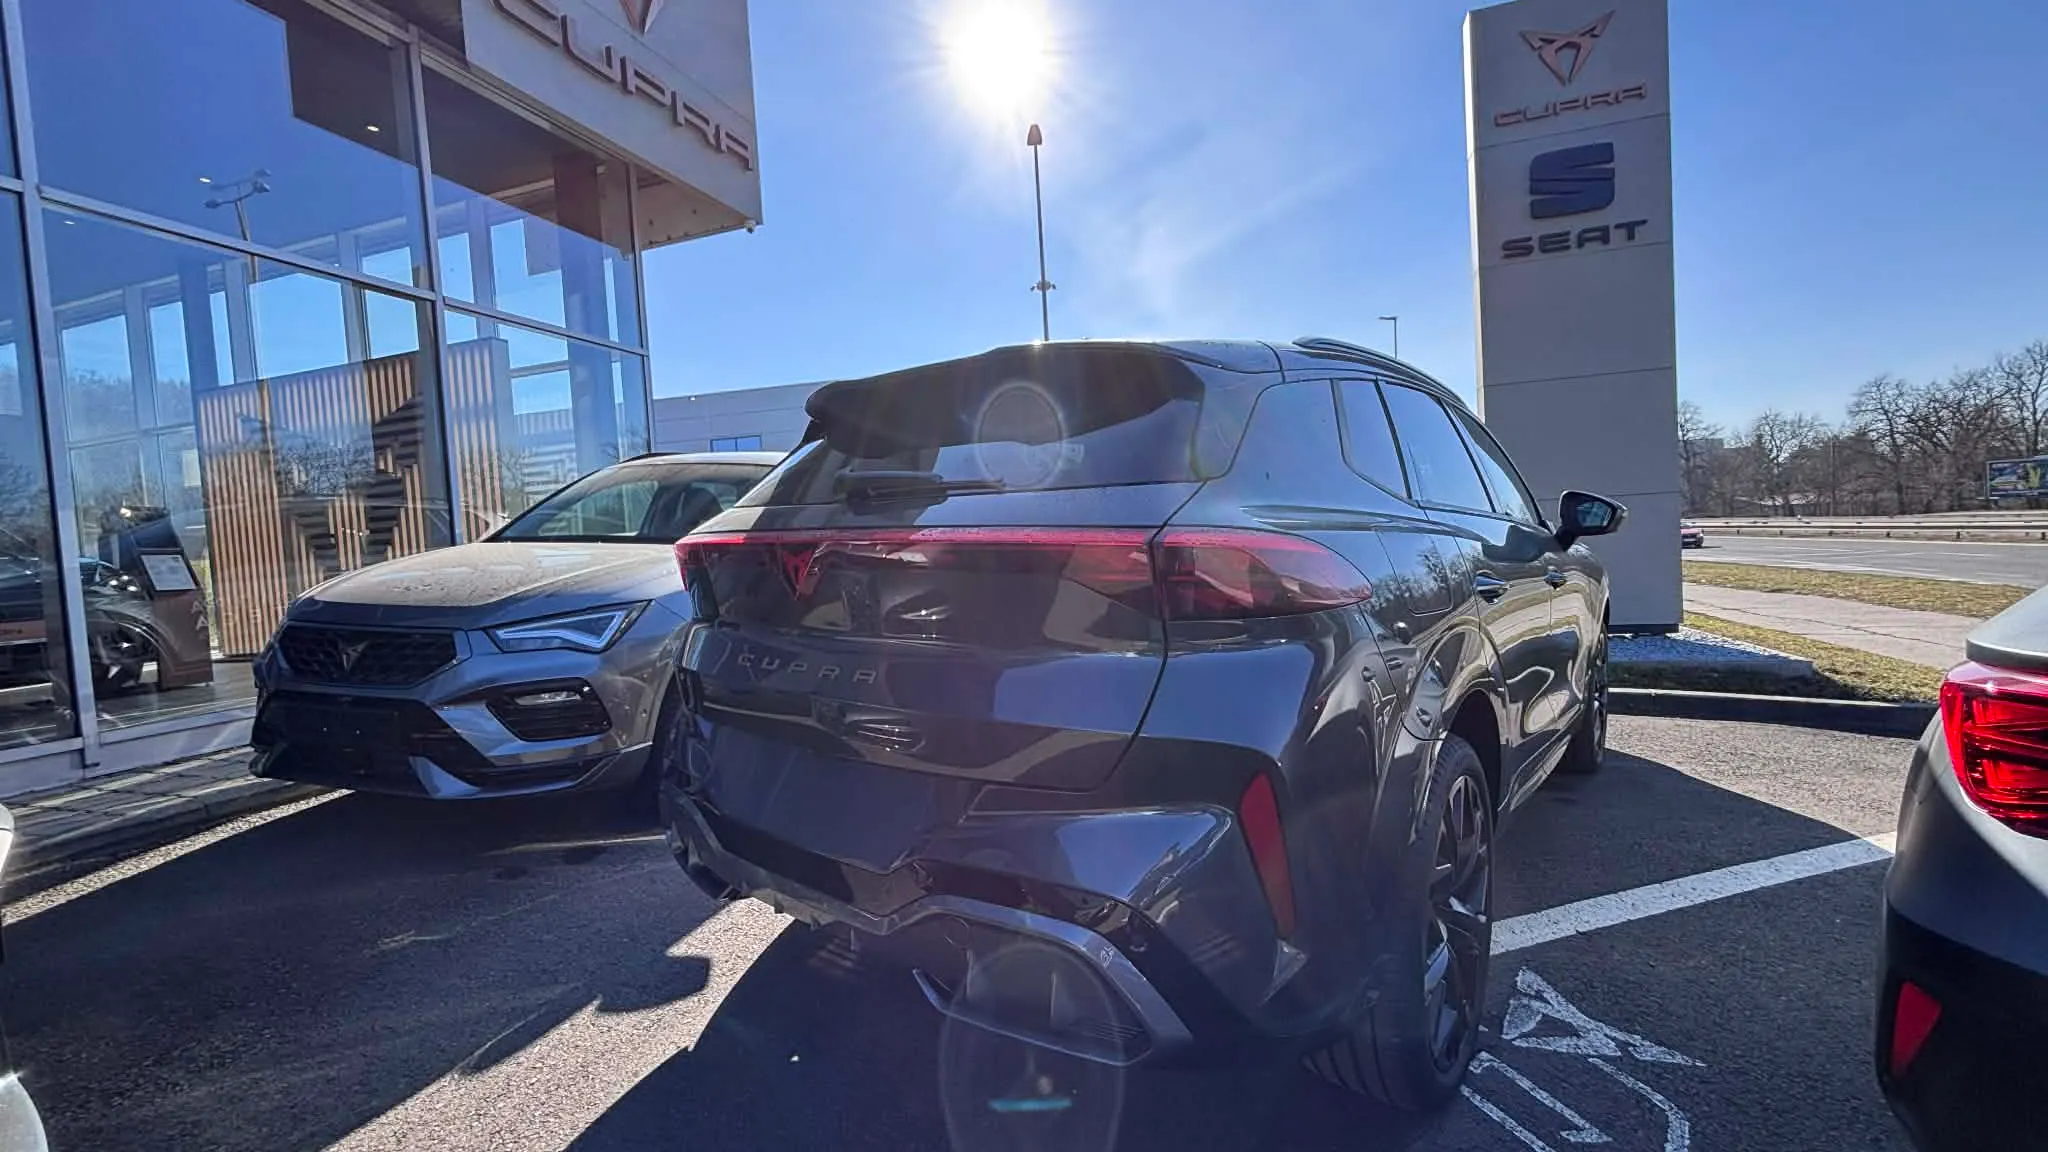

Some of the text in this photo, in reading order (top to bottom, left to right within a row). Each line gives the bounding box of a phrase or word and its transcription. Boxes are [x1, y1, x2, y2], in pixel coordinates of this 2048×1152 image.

[1493, 83, 1648, 127] CUPRA
[1501, 219, 1649, 259] SEAT
[737, 653, 877, 684] CUPRA
